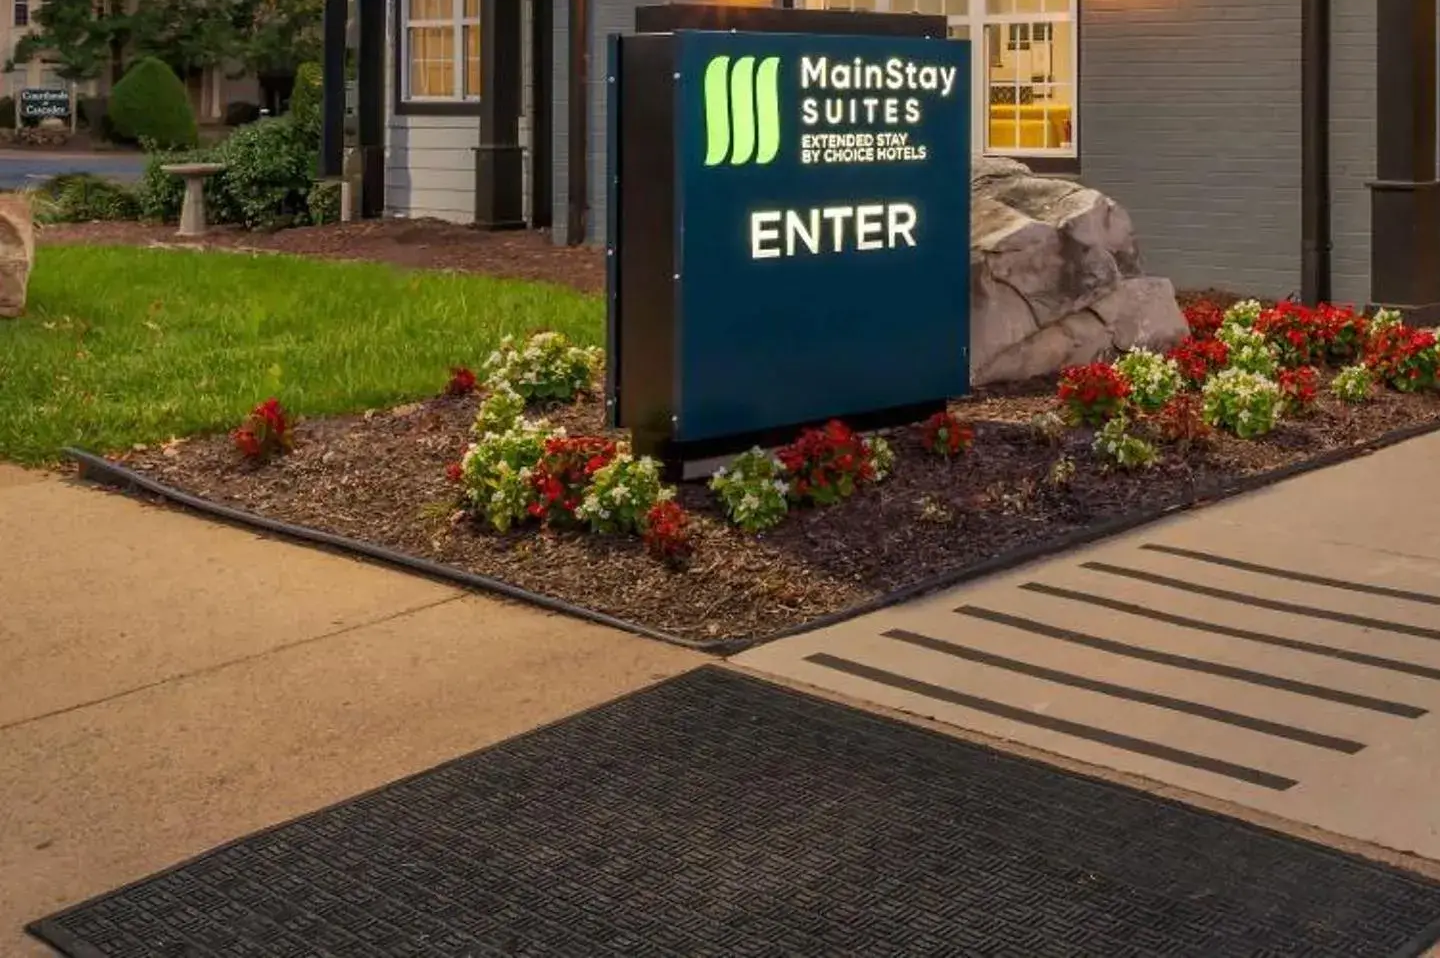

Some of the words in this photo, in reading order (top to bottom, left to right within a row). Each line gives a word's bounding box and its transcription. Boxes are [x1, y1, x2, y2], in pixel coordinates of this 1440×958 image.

[801, 56, 957, 97] MainStay
[801, 97, 921, 125] SUITES
[801, 134, 874, 149] EXTENDED
[876, 132, 909, 147] STAY
[801, 149, 821, 165] BY
[823, 147, 875, 163] CHOICE
[876, 145, 927, 161] HOTELS
[751, 203, 918, 259] ENTER
